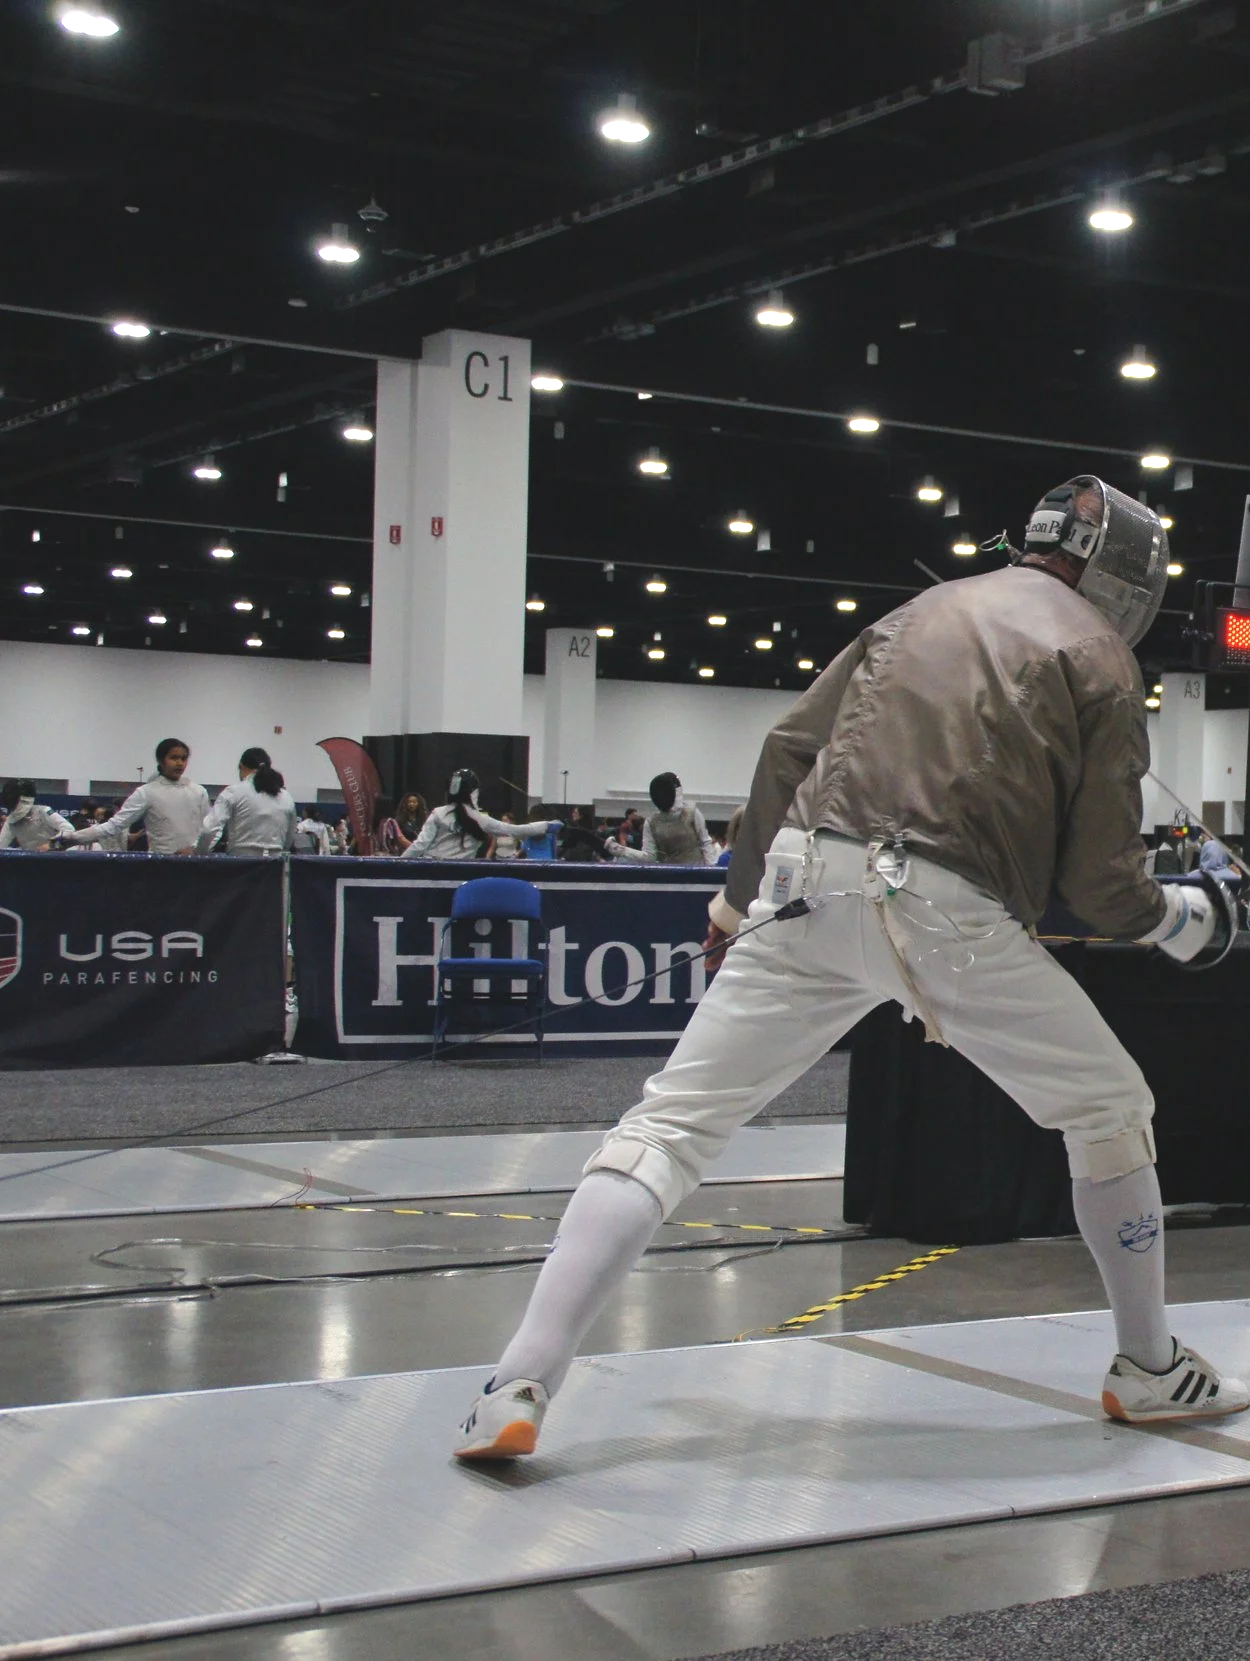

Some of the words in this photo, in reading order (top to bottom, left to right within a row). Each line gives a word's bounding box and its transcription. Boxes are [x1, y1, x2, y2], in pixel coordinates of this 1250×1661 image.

[464, 350, 513, 402] C1
[568, 636, 590, 658] A2
[1184, 680, 1201, 699] A3
[343, 767, 360, 793] CLUB
[59, 931, 203, 962] USA
[371, 915, 708, 1007] Hilton
[43, 971, 219, 985] PARAFENCING
